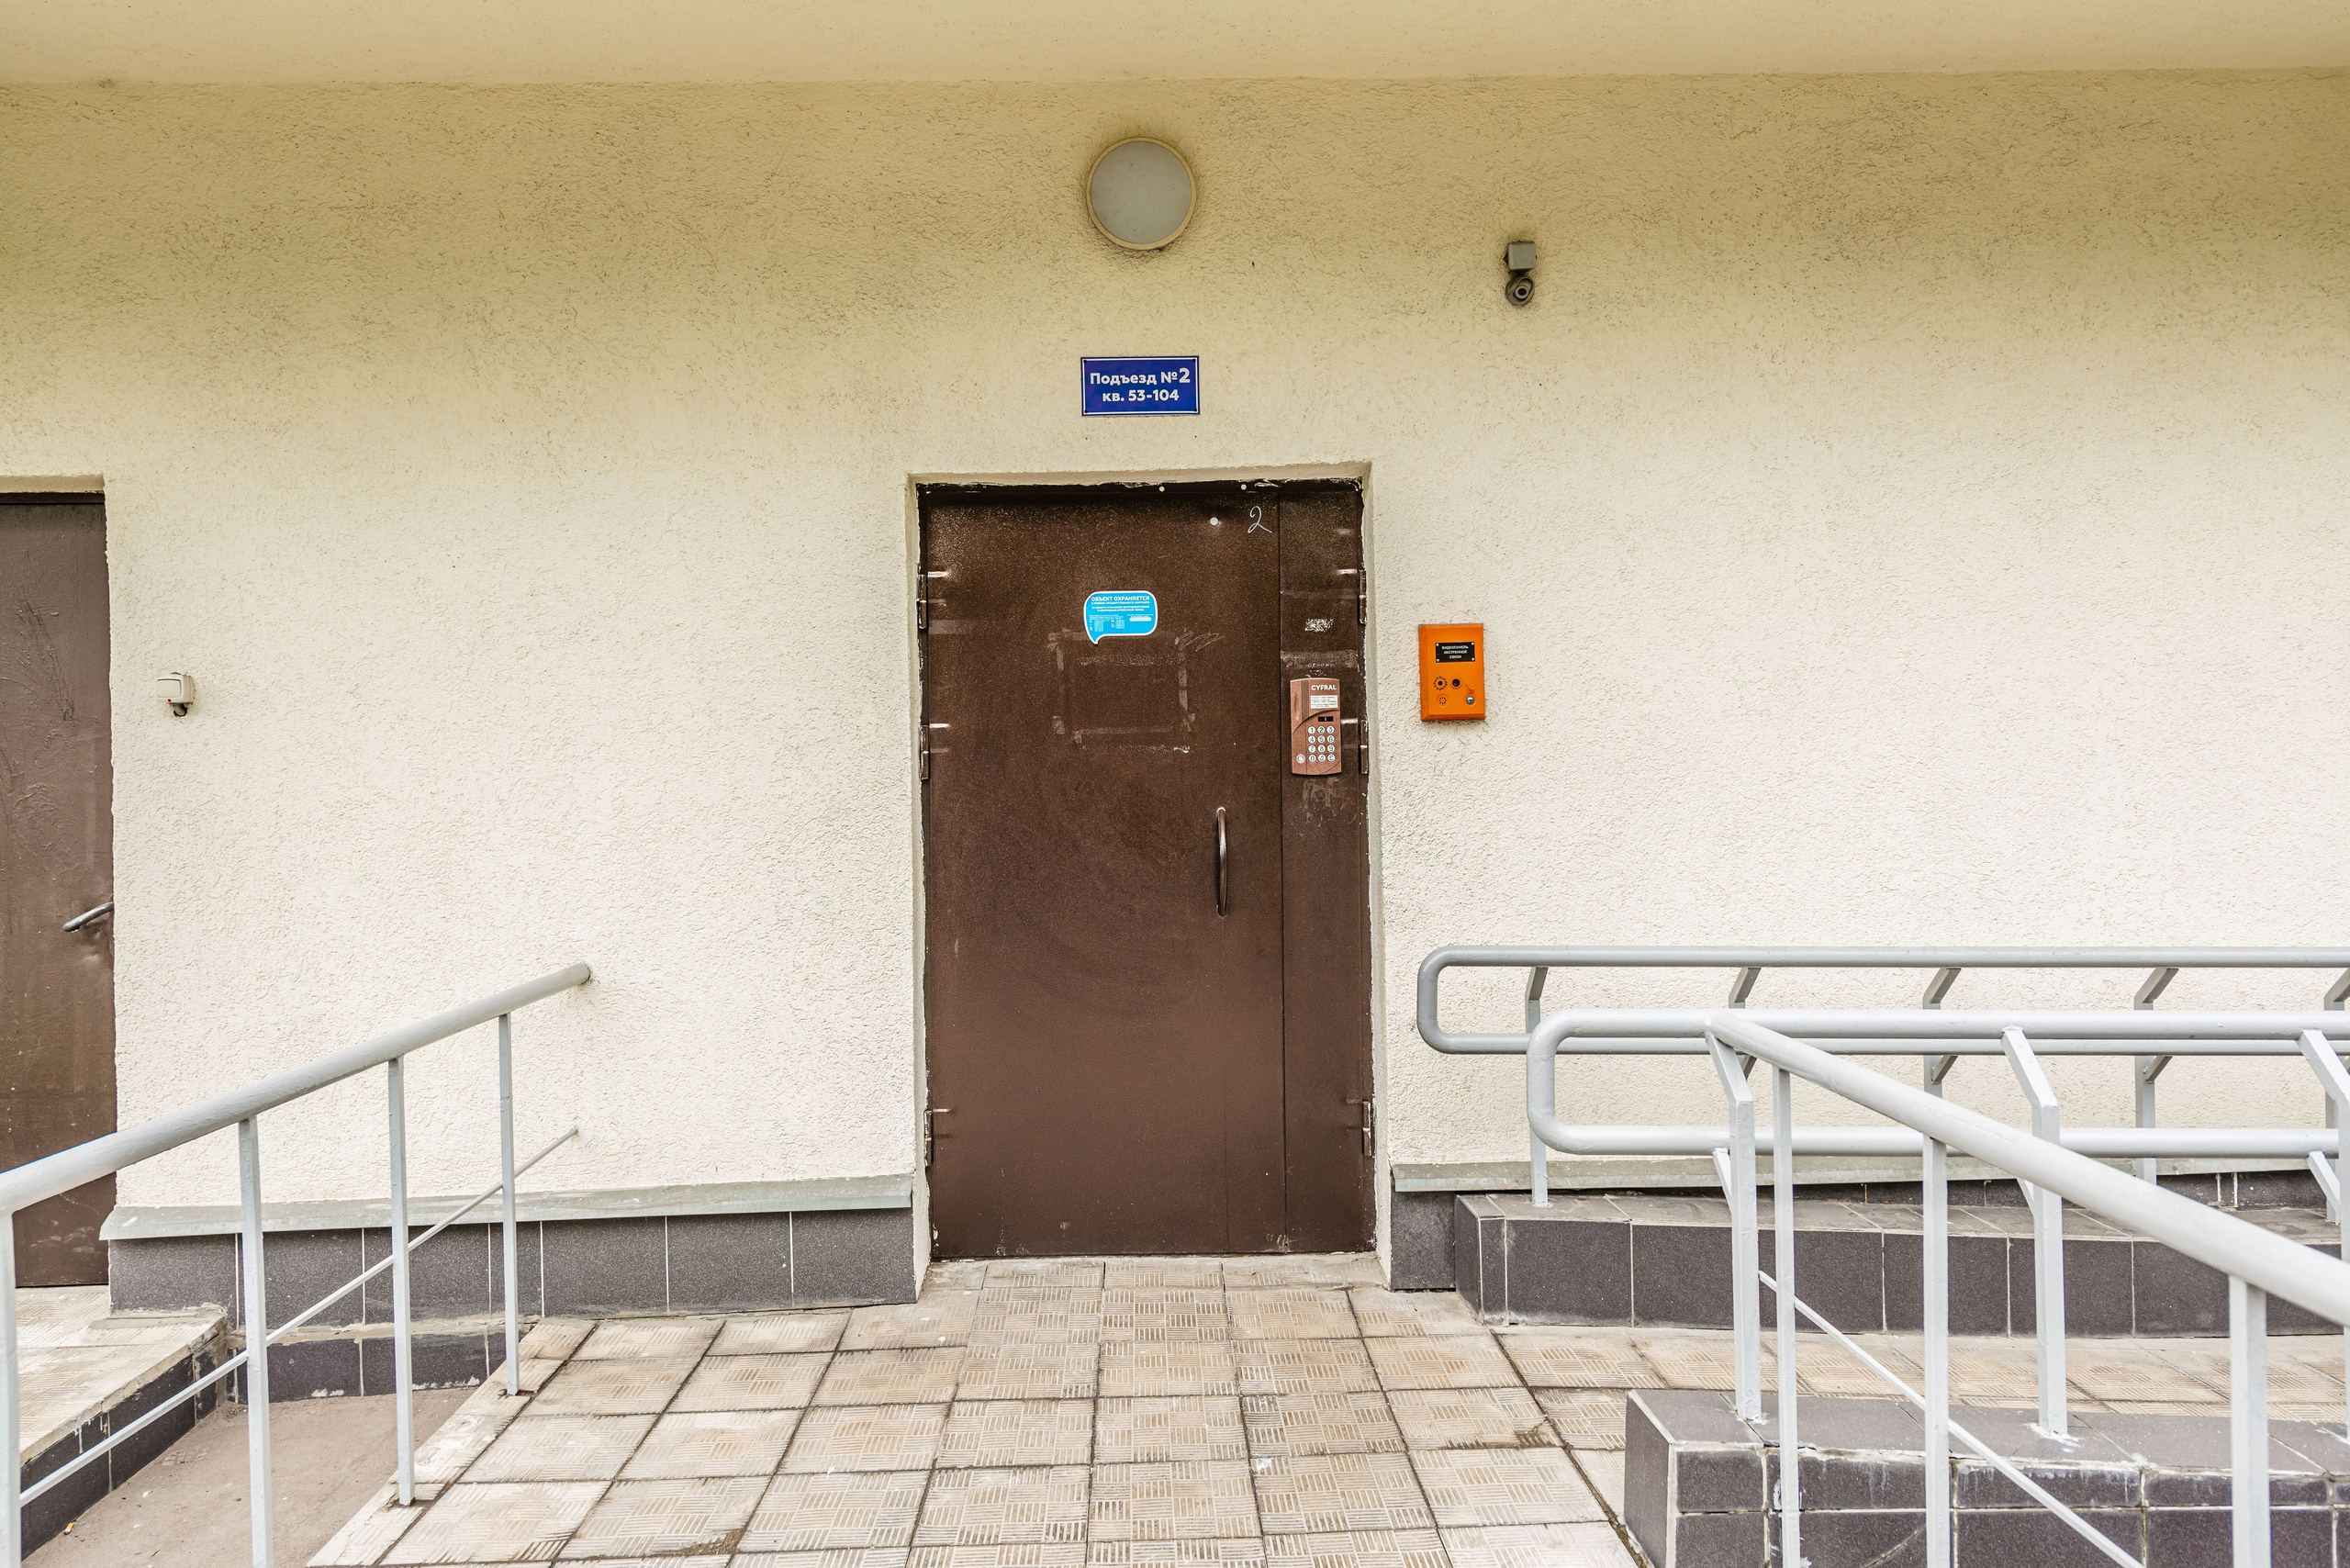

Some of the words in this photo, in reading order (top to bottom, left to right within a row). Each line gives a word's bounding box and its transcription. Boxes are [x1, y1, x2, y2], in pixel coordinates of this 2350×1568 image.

[1090, 372, 1158, 386] Подъезд
[1102, 392, 1125, 402] кв.
[1128, 389, 1180, 401] 53-104
[1248, 505, 1272, 533] 2
